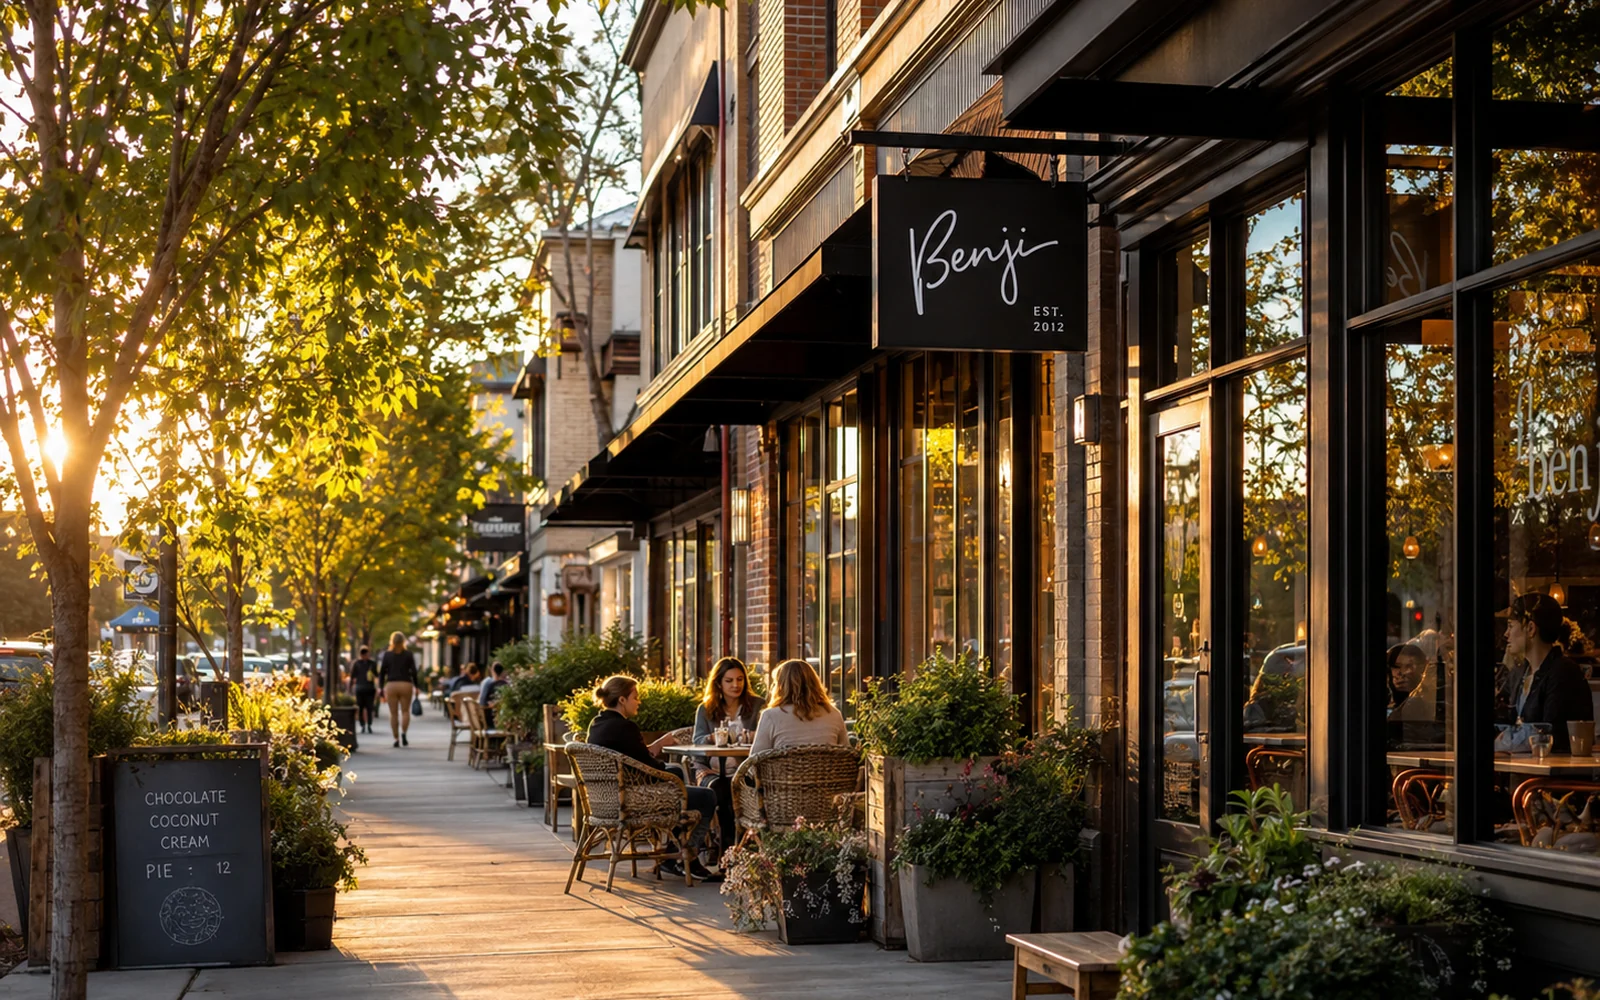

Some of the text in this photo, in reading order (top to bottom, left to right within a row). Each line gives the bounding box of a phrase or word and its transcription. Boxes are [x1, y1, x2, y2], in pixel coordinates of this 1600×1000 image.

[909, 209, 1059, 316] Benji
[1033, 306, 1063, 317] EST.
[1033, 321, 1064, 332] 2012
[145, 790, 227, 806] CHOCOLATE
[150, 813, 219, 829] COCONUT
[160, 835, 210, 850] CREAM
[146, 863, 173, 879] PIE
[216, 861, 231, 875] 12
